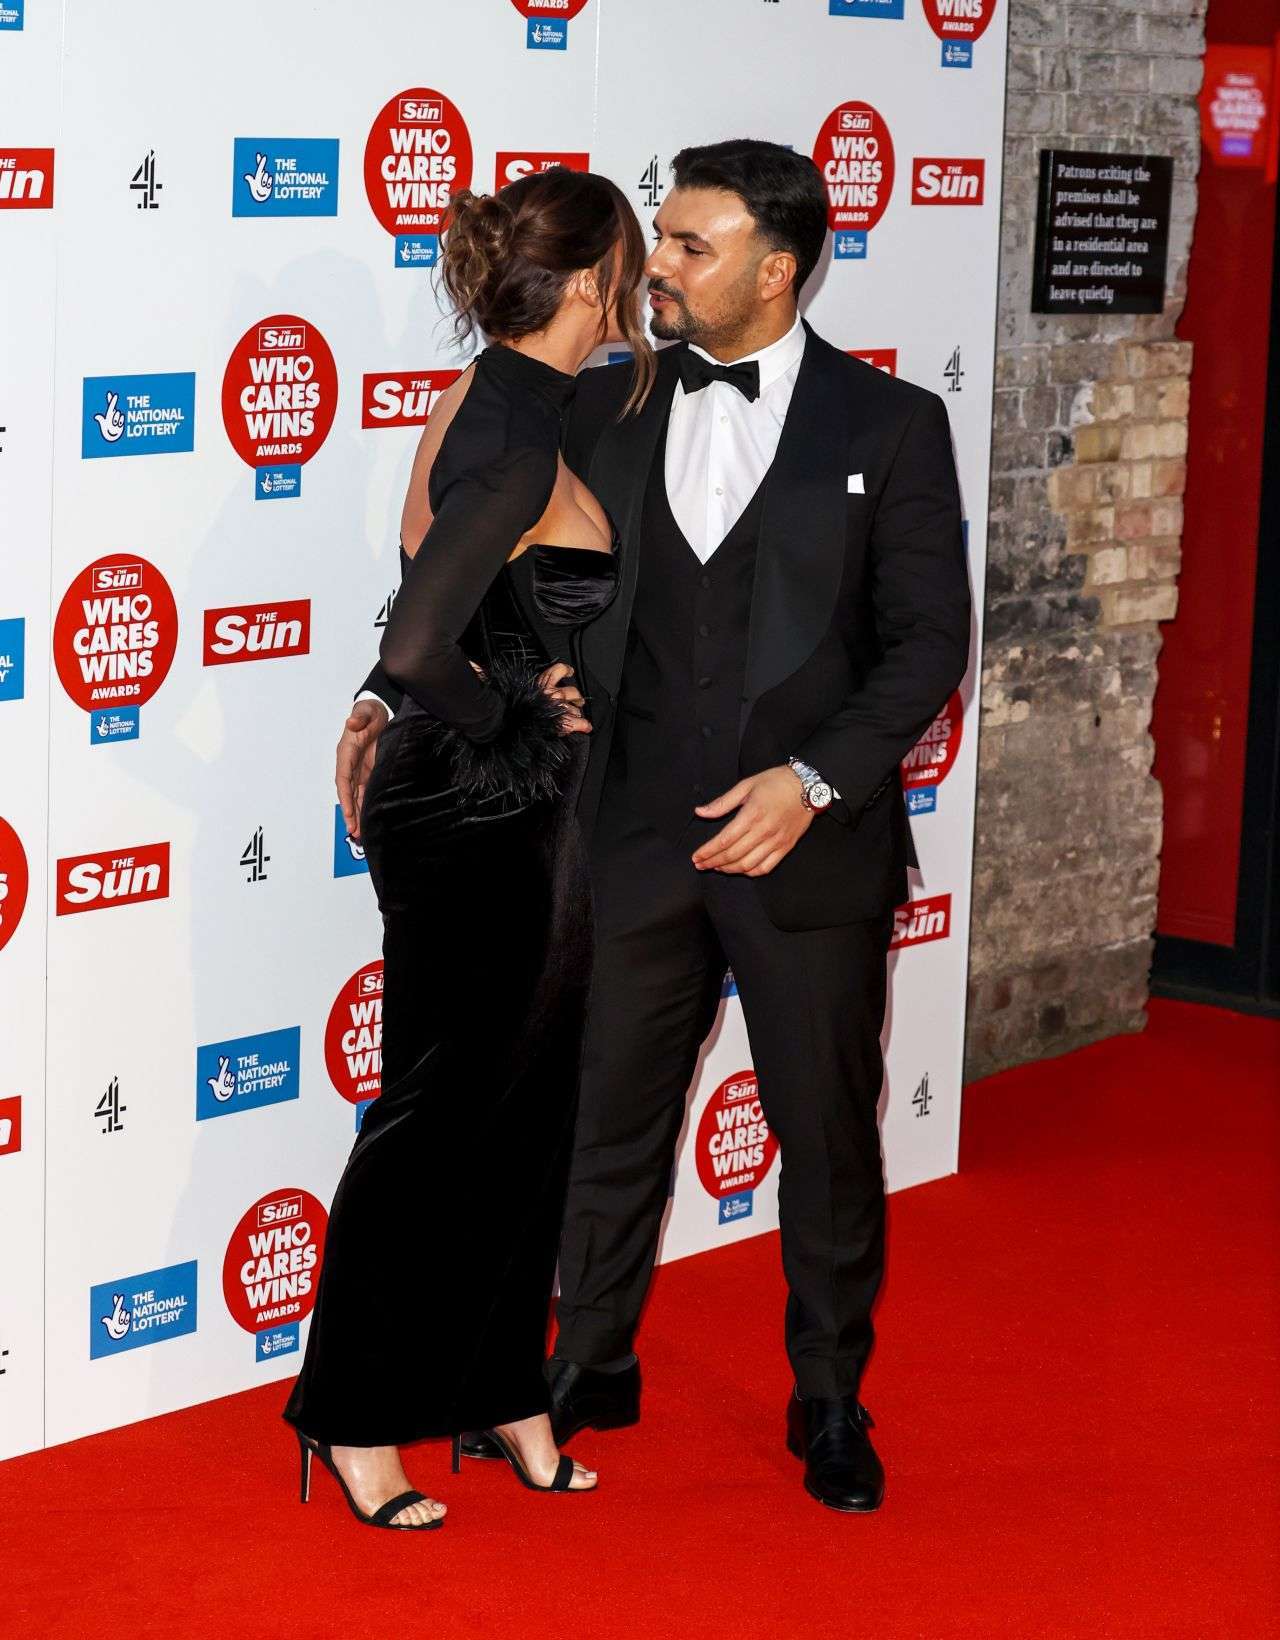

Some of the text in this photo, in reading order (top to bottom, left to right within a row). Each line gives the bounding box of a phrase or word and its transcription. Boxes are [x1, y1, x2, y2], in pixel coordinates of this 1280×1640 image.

[936, 0, 983, 18] WINS
[402, 102, 439, 120] Sun
[841, 114, 870, 129] Sun
[389, 128, 451, 154] WHO
[831, 136, 878, 159] WHO
[274, 159, 296, 170] THE
[381, 155, 456, 181] CARES
[824, 160, 882, 183] CARES
[947, 166, 962, 174] THE
[1057, 164, 1151, 183] Patrons exiting the
[274, 173, 328, 184] NATIONAL
[916, 164, 979, 198] Sun
[274, 187, 322, 198] LOTTERY
[386, 183, 450, 208] WINS
[827, 184, 878, 207] WINS
[1056, 188, 1140, 206] premises shall be
[396, 214, 439, 225] AWARDS
[1055, 212, 1157, 233] advised that they are
[1053, 236, 1148, 252] in a residential area
[1052, 260, 1142, 276] and are directed to
[1050, 285, 1114, 304] leave quietly
[262, 330, 301, 348] Sun
[249, 356, 314, 383] WHO
[410, 380, 432, 389] THE
[127, 396, 150, 408] THE
[240, 382, 320, 412] CARES
[127, 409, 184, 423] NATIONAL
[245, 410, 315, 440] WINS
[127, 423, 177, 437] LOTTERY
[256, 443, 302, 456] AWARDS
[97, 571, 139, 588] Sun
[82, 594, 152, 625] WHO
[256, 612, 278, 623] THE
[73, 621, 159, 655] CARES
[210, 615, 302, 655] Sun
[79, 651, 153, 683] WINS
[91, 684, 140, 700] AWARDS
[112, 857, 136, 869] THE
[64, 862, 160, 903] Sun
[891, 911, 945, 944] Sun
[237, 1054, 259, 1068] THE
[237, 1061, 290, 1081] NATIONAL
[237, 1075, 284, 1095] LOTTERY
[726, 1084, 756, 1100] Sun
[716, 1100, 763, 1132] WHO
[709, 1121, 769, 1156] CARES
[712, 1144, 764, 1178] WINS
[720, 1171, 755, 1190] AWARDS
[262, 1202, 299, 1222] Sun
[248, 1222, 311, 1258] WHO
[240, 1244, 317, 1285] CARES
[132, 1290, 154, 1305] THE
[245, 1271, 312, 1309] WINS
[132, 1296, 188, 1318] NATIONAL
[256, 1302, 300, 1323] AWARDS
[132, 1309, 180, 1332] LOTTERY
